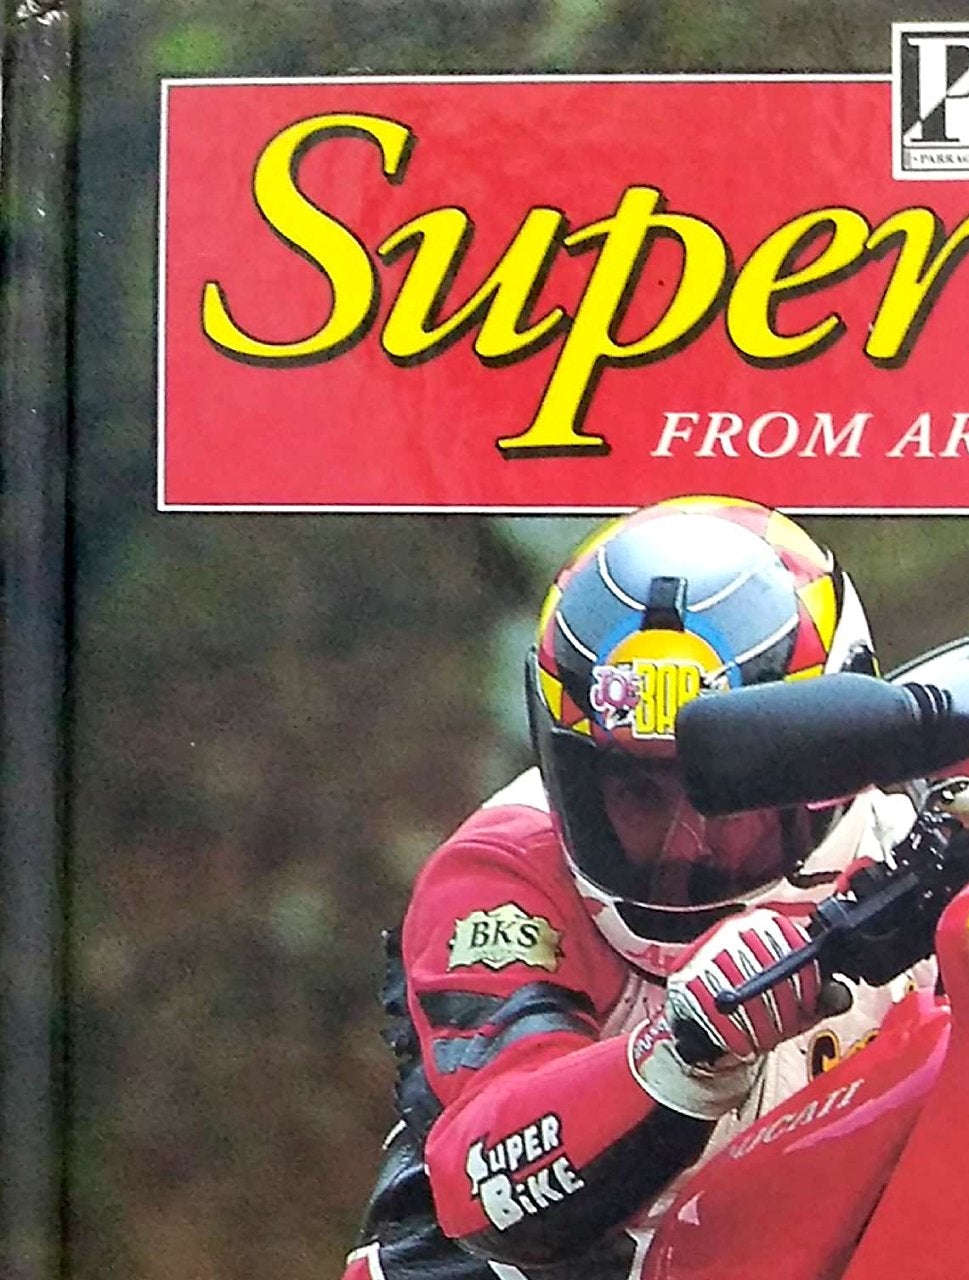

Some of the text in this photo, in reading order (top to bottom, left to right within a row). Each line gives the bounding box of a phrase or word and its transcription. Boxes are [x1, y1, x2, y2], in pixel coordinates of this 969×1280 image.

[651, 412, 871, 458] FROM
[470, 919, 541, 949] BKS
[465, 1114, 561, 1196] SUPER
